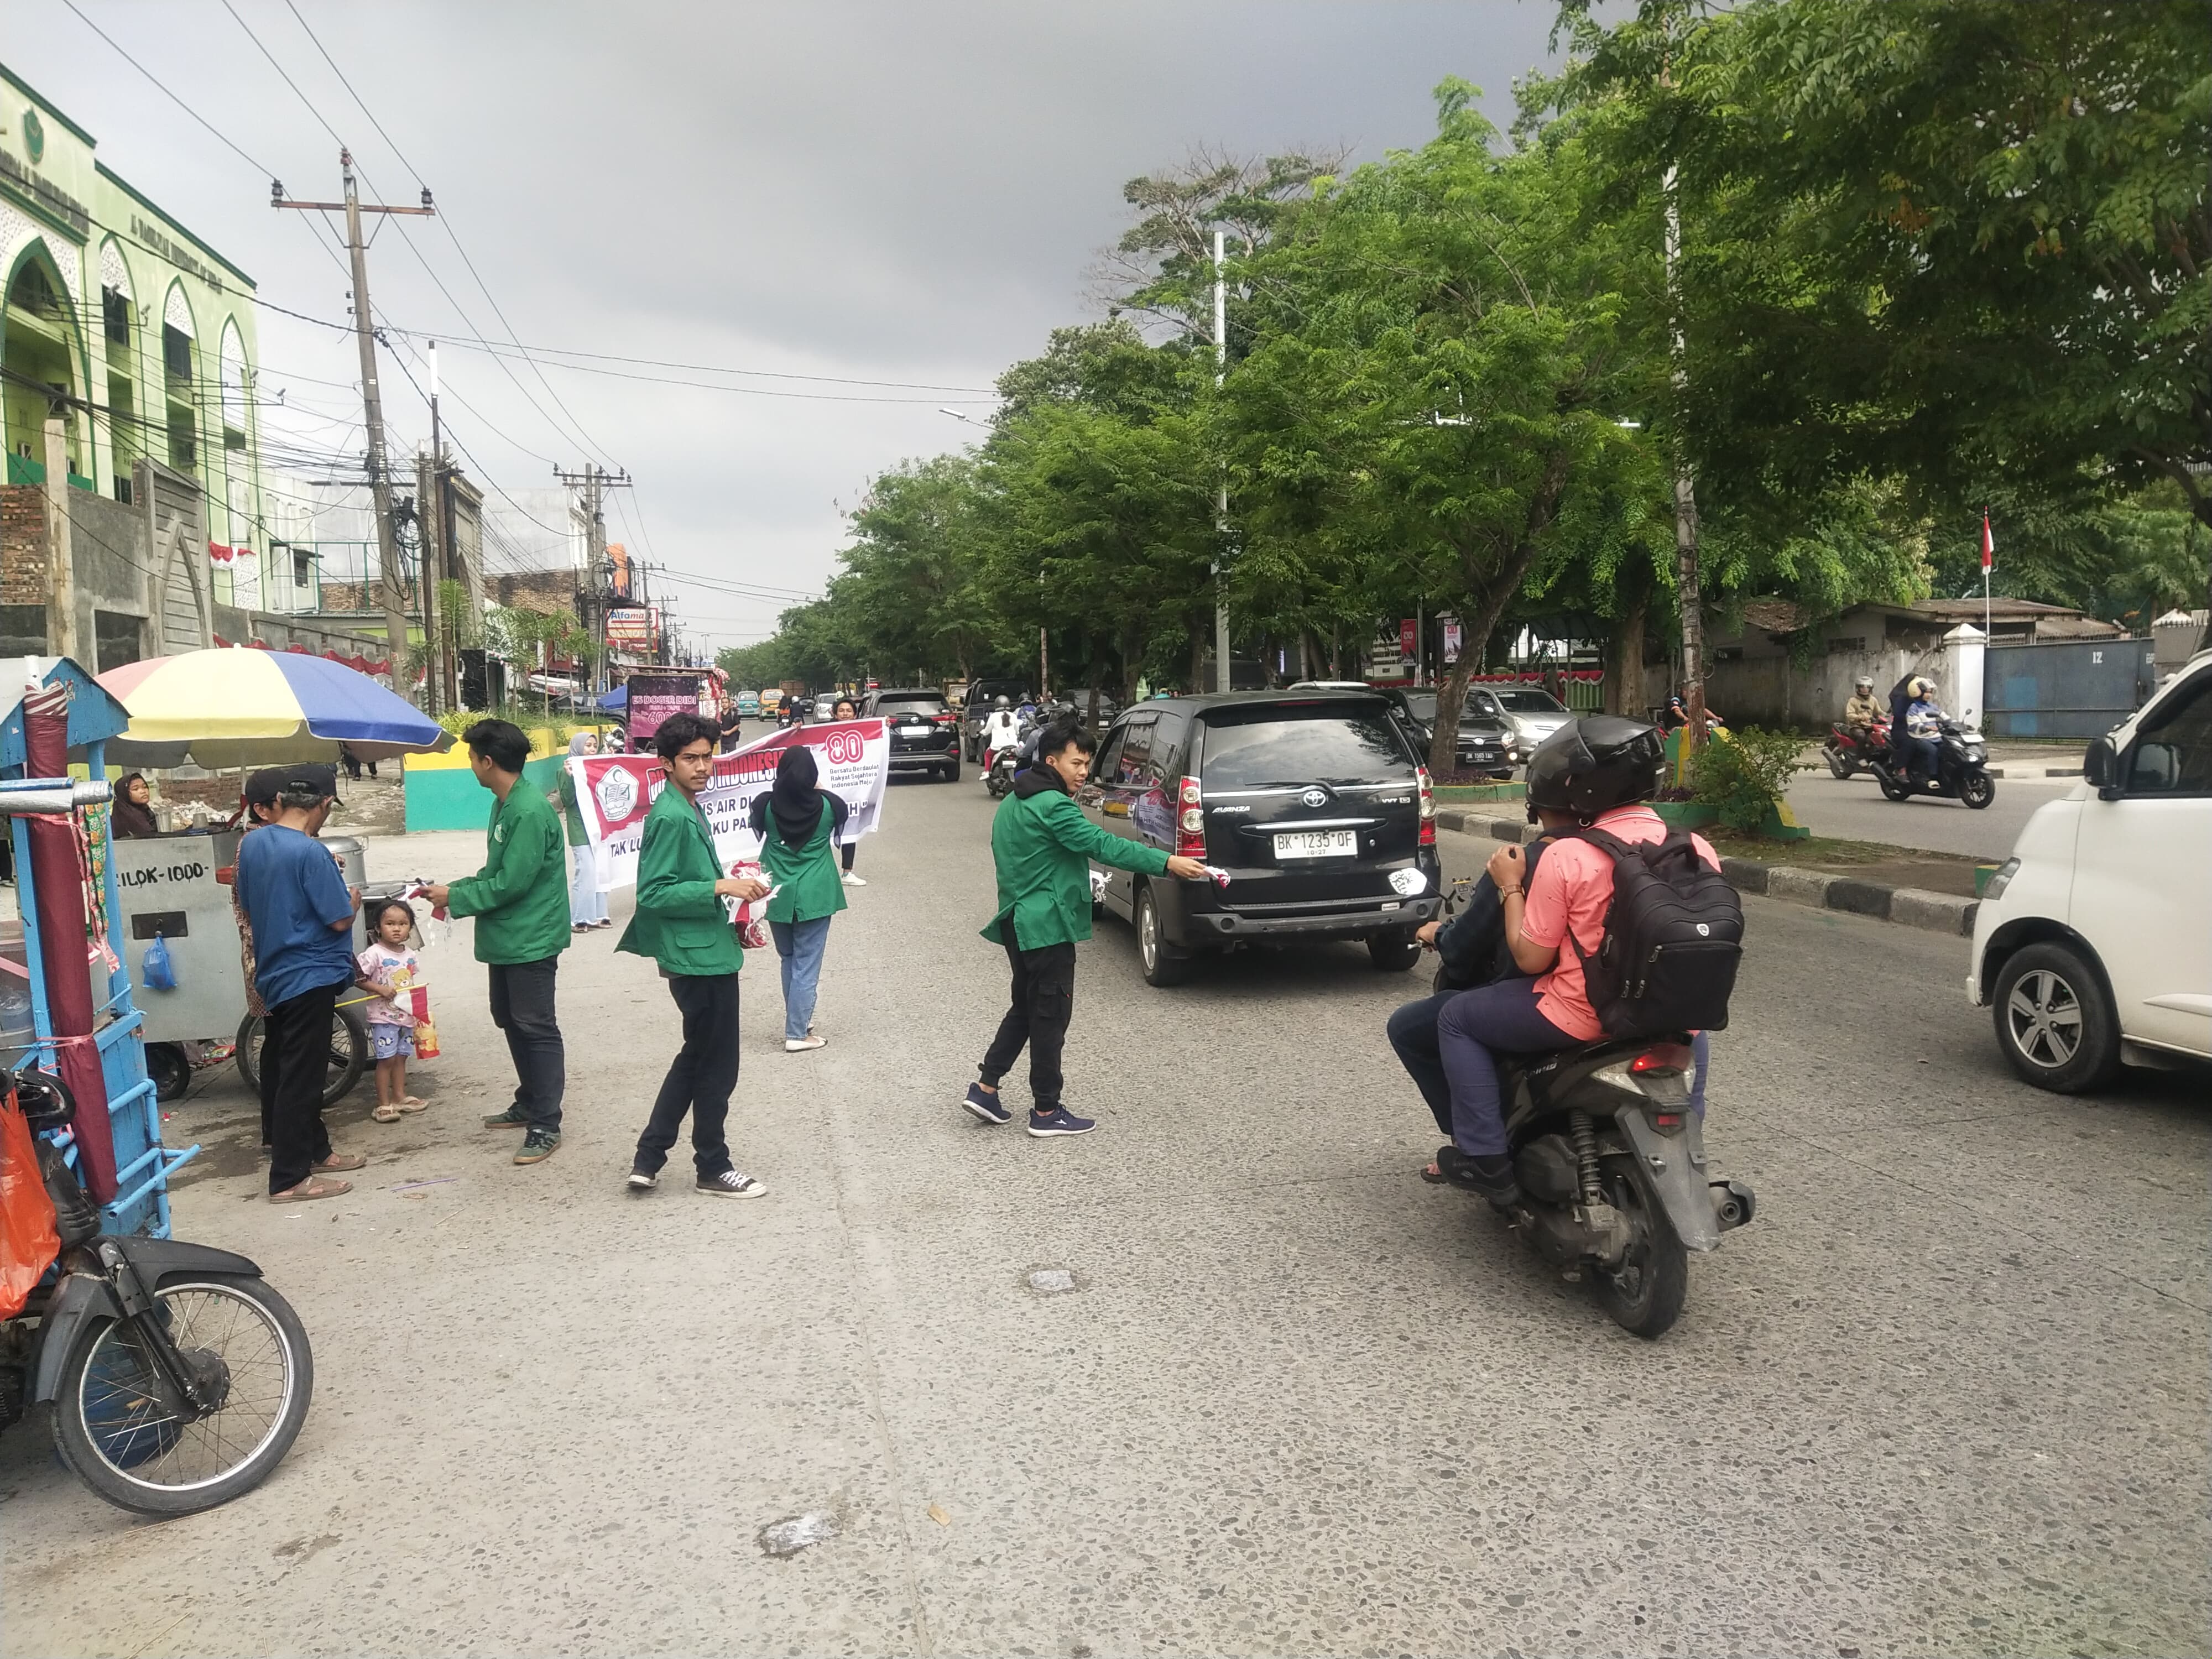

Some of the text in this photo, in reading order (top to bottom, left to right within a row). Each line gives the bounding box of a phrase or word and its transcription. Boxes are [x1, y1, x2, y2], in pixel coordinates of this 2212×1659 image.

[632, 696, 643, 705] ES
[644, 695, 675, 705] DOGER
[676, 695, 696, 705] DIDI
[717, 799, 735, 814] AIR
[1277, 835, 1292, 849] BK
[1301, 833, 1330, 848] 1235
[611, 840, 626, 858] TAK
